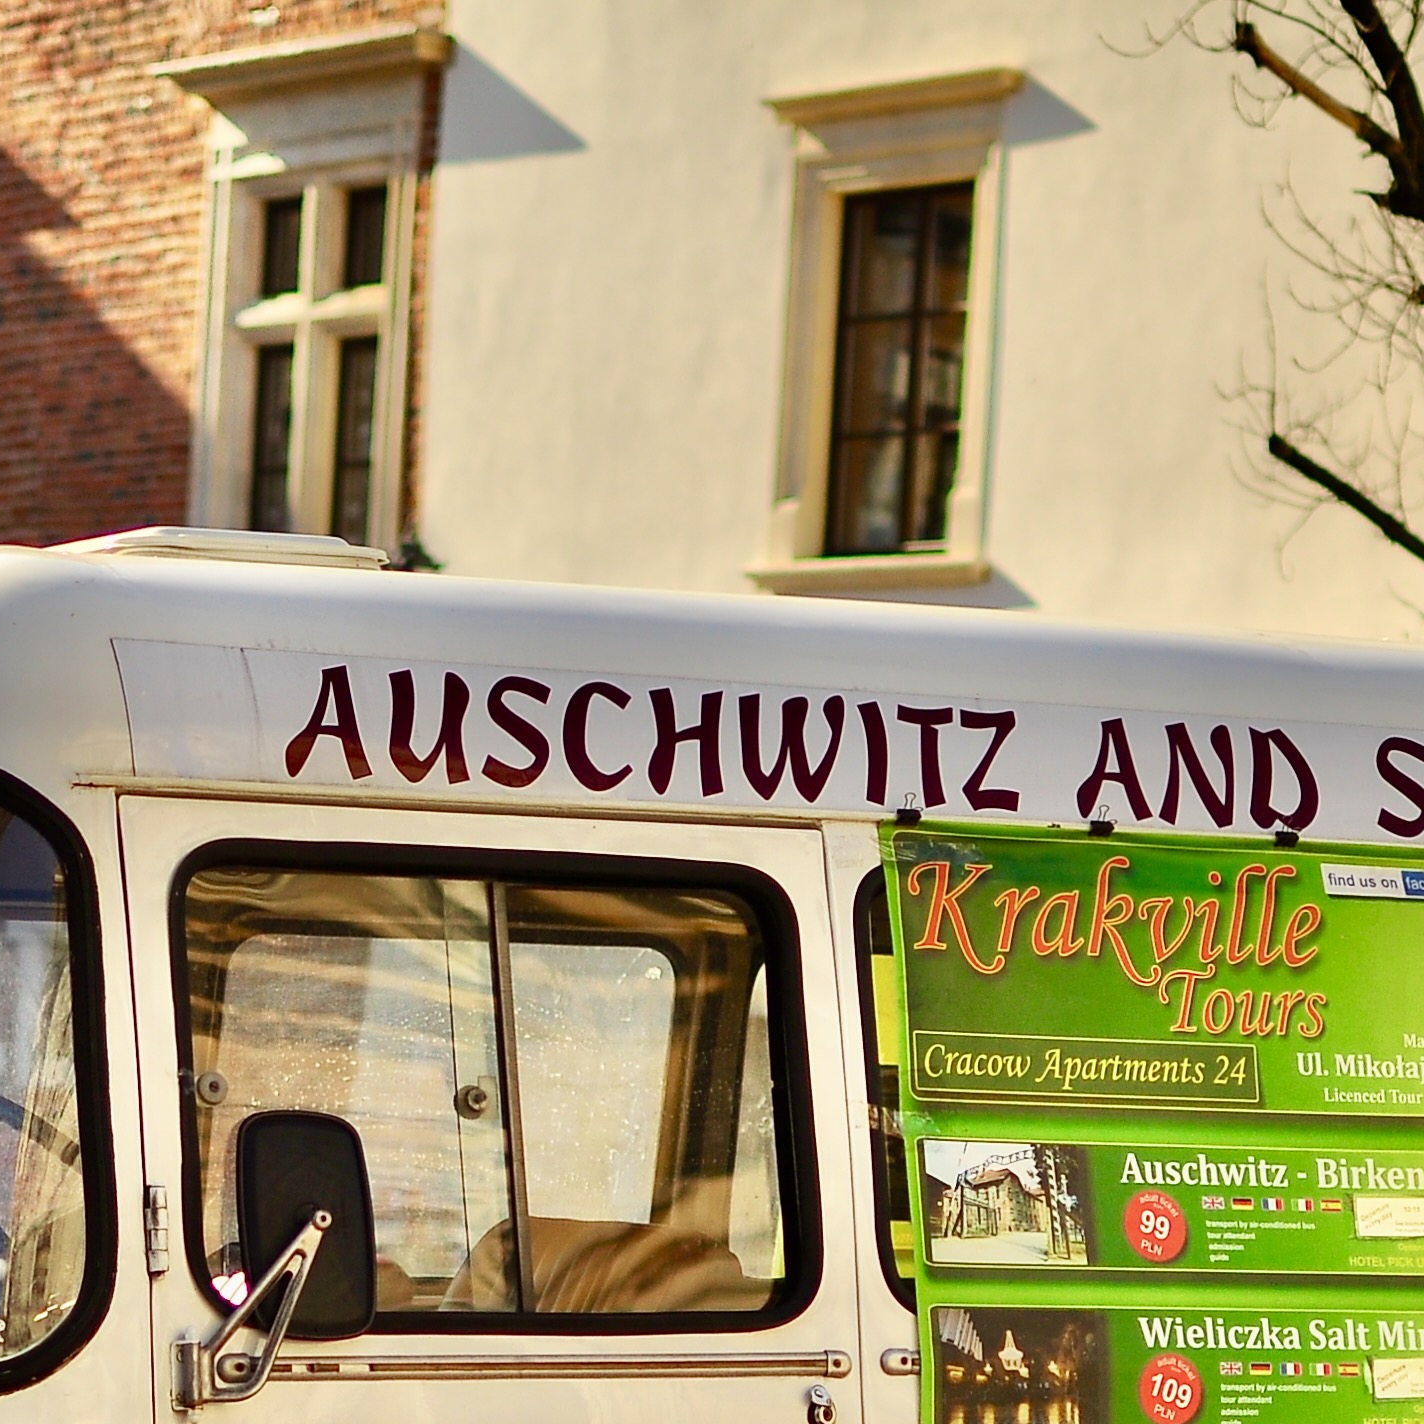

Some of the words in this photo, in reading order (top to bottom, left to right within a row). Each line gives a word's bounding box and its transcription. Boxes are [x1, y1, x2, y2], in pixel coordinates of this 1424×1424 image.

[284, 665, 1021, 813] AUSCHWITZ
[1077, 717, 1319, 832] AND
[1328, 873, 1354, 886] find
[1360, 877, 1376, 887] us
[1381, 878, 1397, 889] on
[908, 856, 1322, 987] Krakville
[1159, 964, 1327, 1038] Tours
[925, 1044, 1030, 1077] Cracow
[1035, 1049, 1205, 1090] Apartments
[1214, 1055, 1246, 1085] 24
[1297, 1053, 1328, 1076] Ul.
[1324, 1088, 1385, 1104] Licenced
[1389, 1090, 1423, 1104] Tour
[1120, 1153, 1288, 1188] Auschwitz
[1140, 1210, 1170, 1239] 99
[1206, 1220, 1237, 1230] transport
[1240, 1221, 1248, 1230] by
[1141, 1239, 1162, 1256] PLN
[1349, 1257, 1385, 1267] HOTEL
[1388, 1257, 1414, 1267] PICK
[1138, 1317, 1301, 1349] Wieliczka
[1310, 1319, 1368, 1351] Salt
[1151, 1374, 1192, 1408] 109
[1221, 1384, 1254, 1392] transport
[1256, 1384, 1265, 1393] by
[1154, 1404, 1175, 1420] PLN
